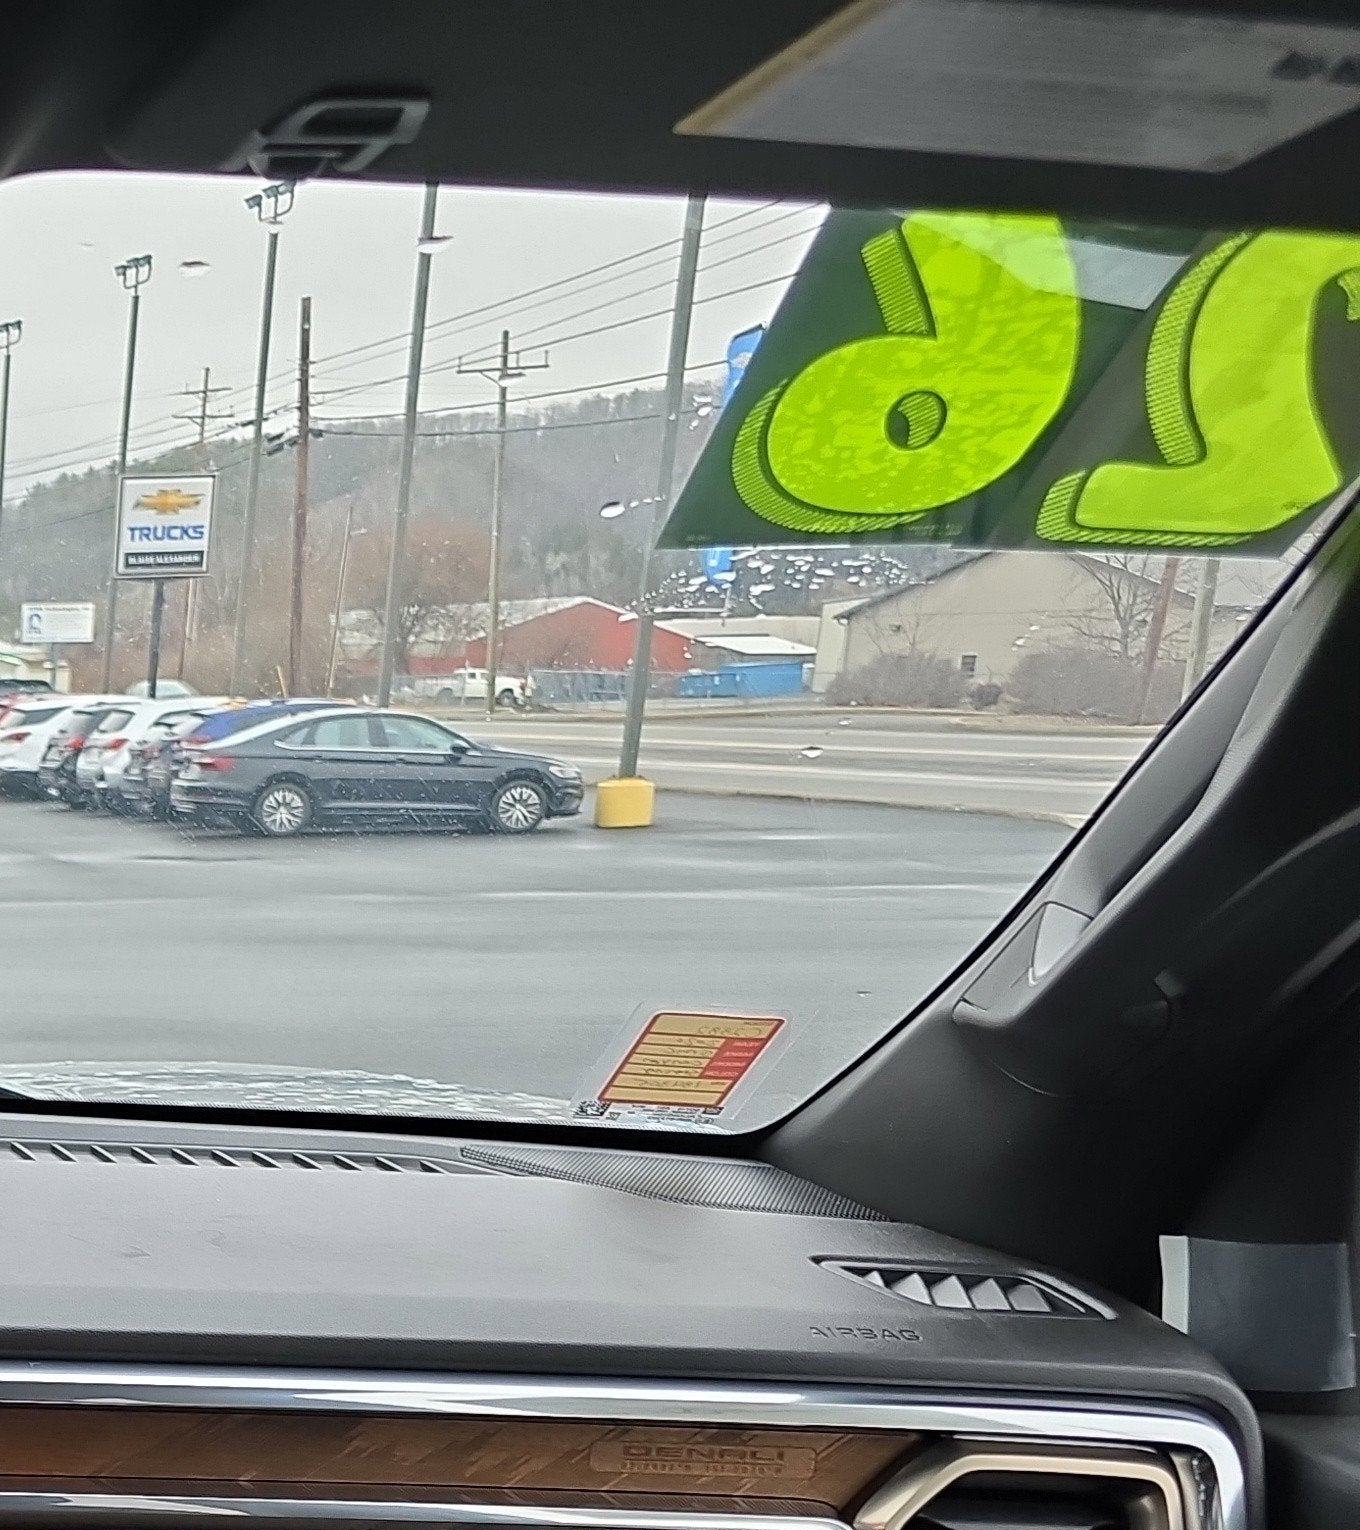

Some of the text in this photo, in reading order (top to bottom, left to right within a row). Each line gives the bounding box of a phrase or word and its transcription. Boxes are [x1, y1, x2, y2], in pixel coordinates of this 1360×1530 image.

[128, 525, 205, 541] TRUCKS
[810, 1326, 921, 1341] AIRBAG
[623, 1446, 784, 1460] DENALI
